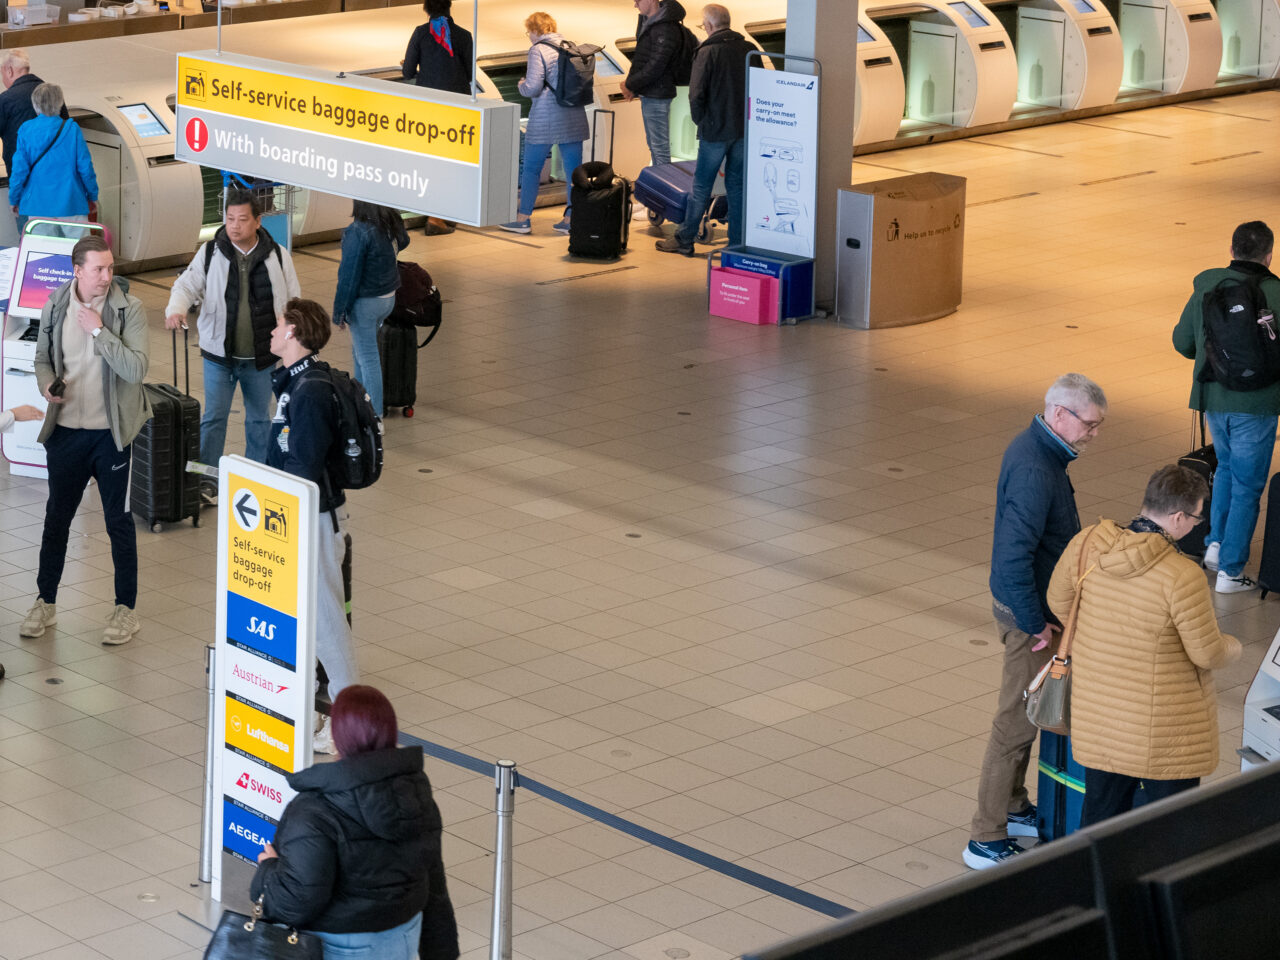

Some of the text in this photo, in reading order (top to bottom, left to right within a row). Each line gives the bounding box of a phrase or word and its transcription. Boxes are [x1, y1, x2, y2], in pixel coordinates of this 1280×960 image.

[776, 79, 806, 88] ICELANDAIR
[211, 77, 476, 147] Self-service baggage drop-off
[755, 98, 784, 109] Does your
[755, 107, 796, 119] carry-on meet
[755, 115, 797, 128] the allowance?
[214, 128, 430, 197] With boarding pass only
[904, 232, 919, 240] Help
[33, 273, 58, 283] baggage
[289, 359, 310, 377] Huf
[233, 536, 286, 566] Self-service
[233, 552, 273, 578] baggage
[232, 570, 272, 593] drop-off
[246, 616, 277, 641] SAS
[232, 663, 274, 693] Austrian
[246, 723, 289, 753] Lufthansa
[250, 778, 282, 804] SWISS
